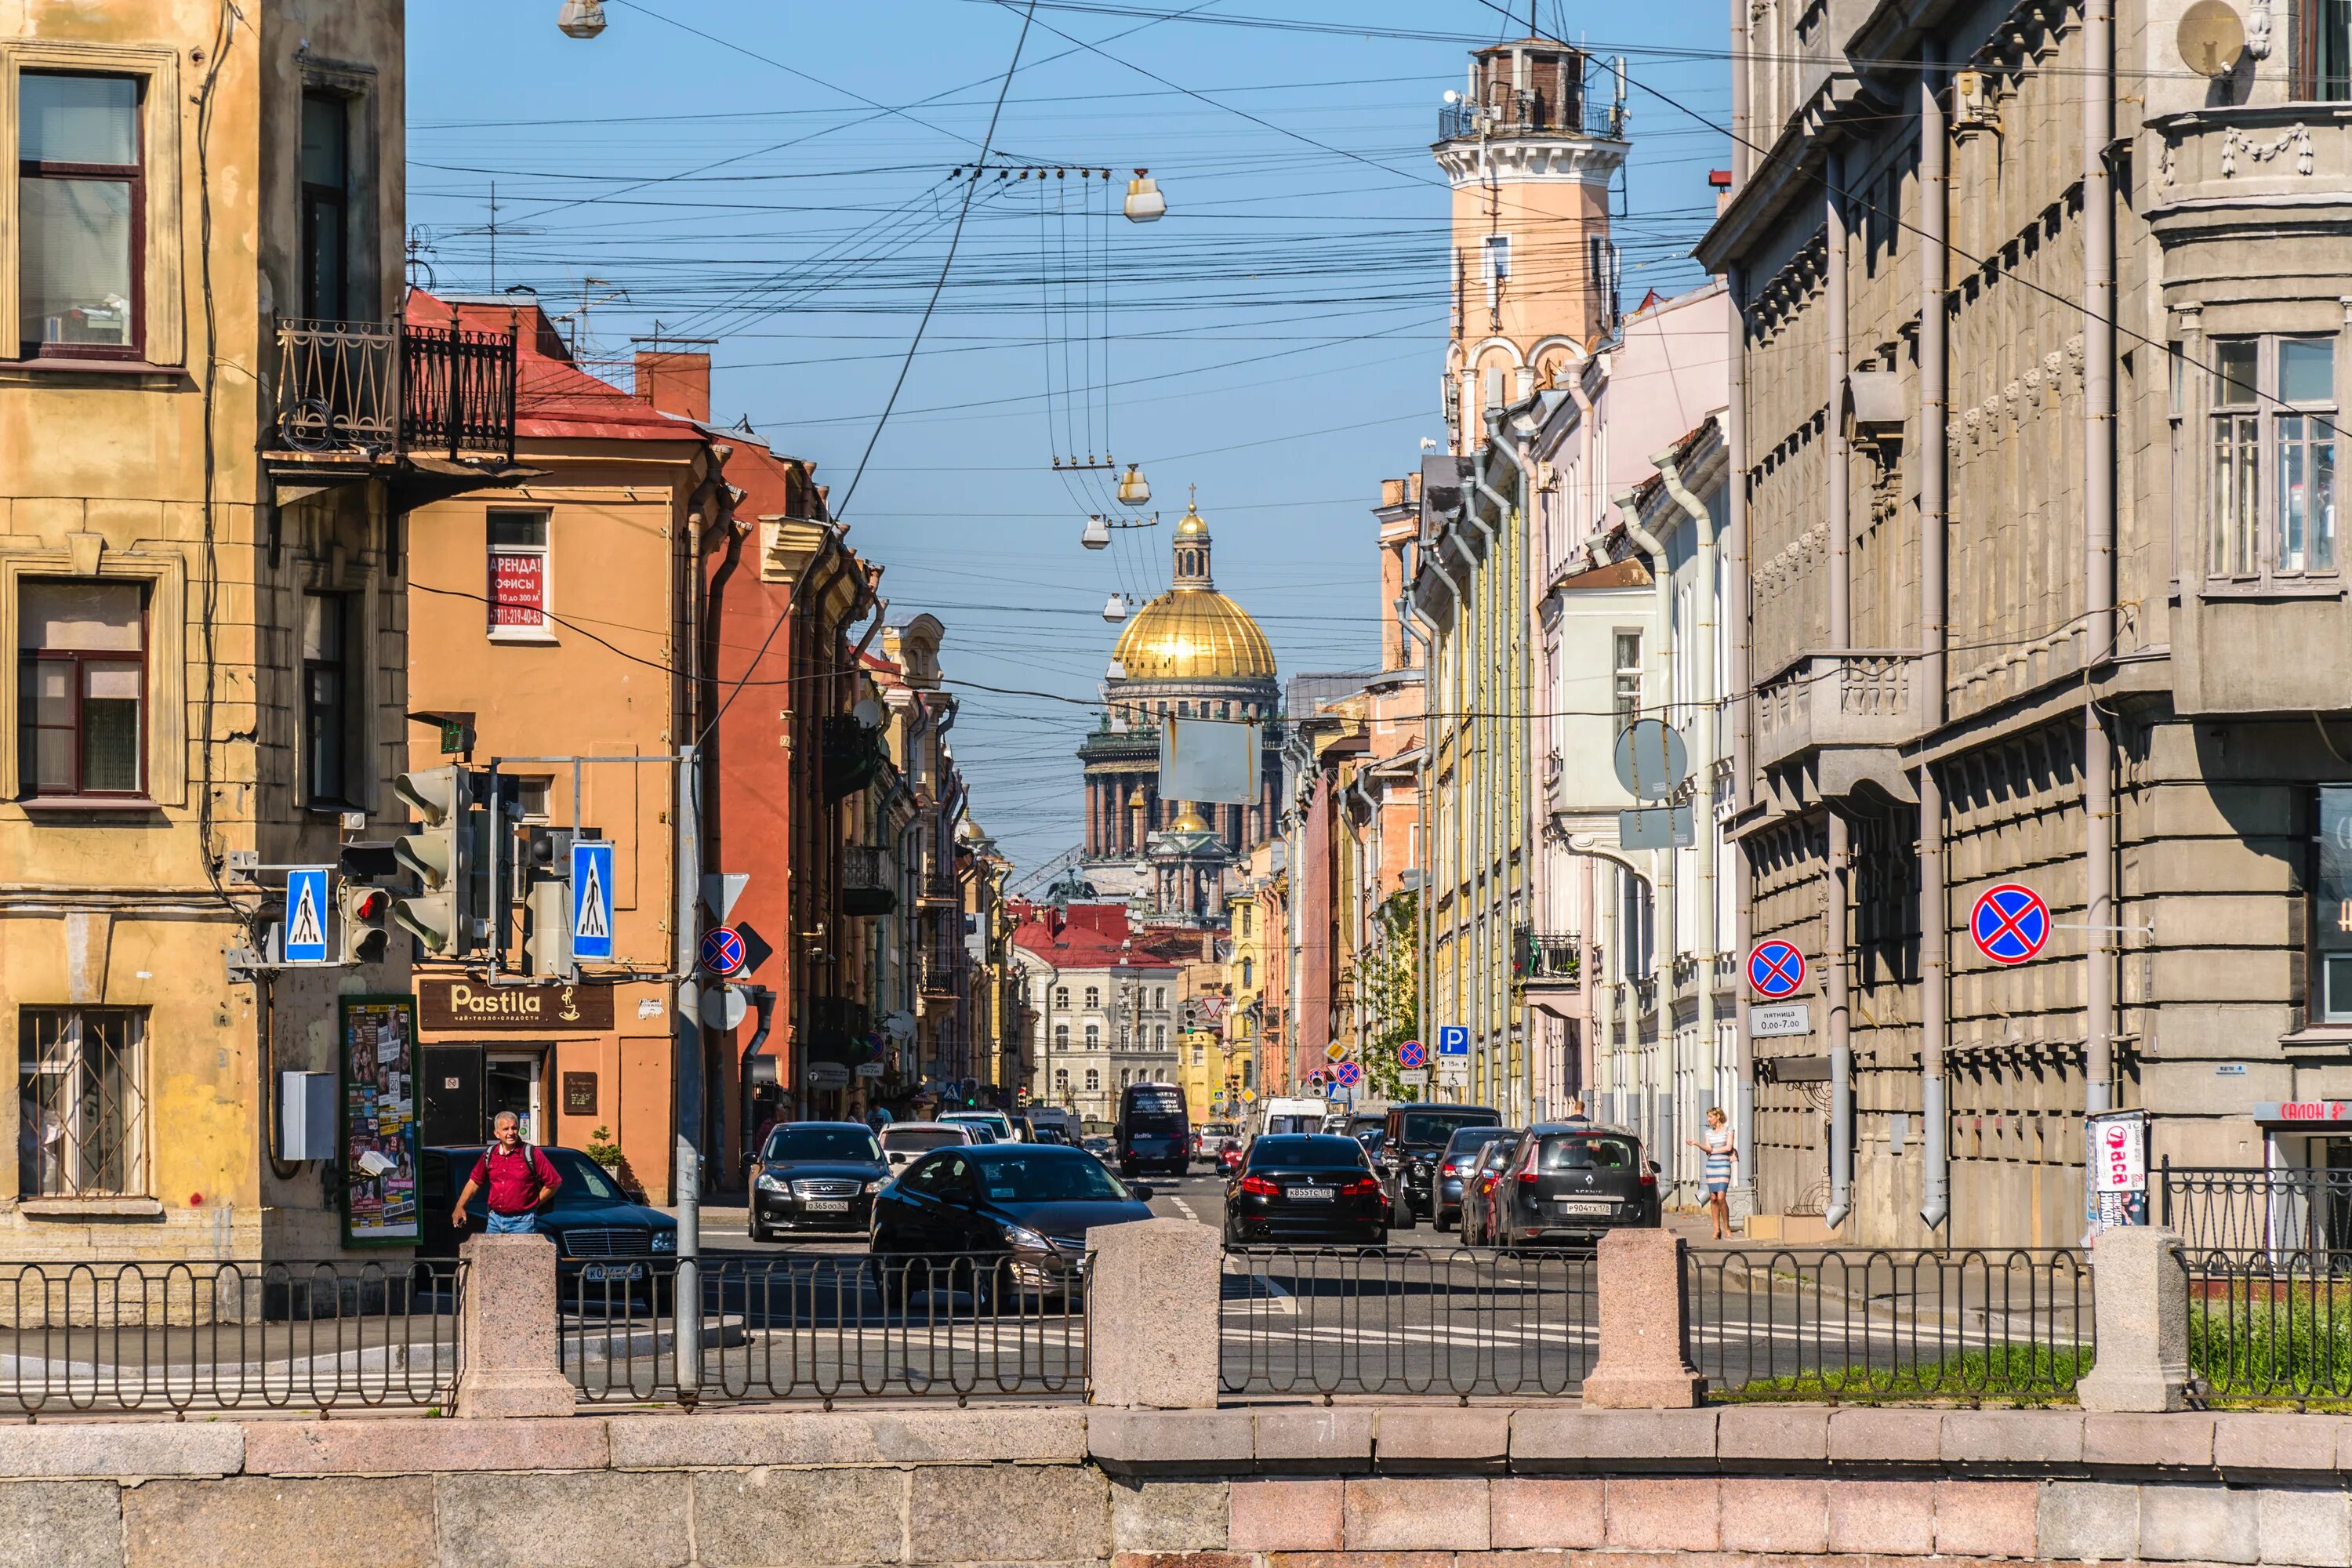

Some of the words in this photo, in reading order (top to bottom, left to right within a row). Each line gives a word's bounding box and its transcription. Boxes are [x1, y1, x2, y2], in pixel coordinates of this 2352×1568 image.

[489, 557, 541, 574] АРЕНДА!
[495, 579, 535, 590] ОФИСЫ
[489, 609, 541, 624] +7911-219-40-63
[451, 984, 540, 1014] Pastila
[1761, 1020, 1800, 1029] 0.00-7.00
[390, 1079, 399, 1091] 20
[2281, 1103, 2325, 1120] САЛОН
